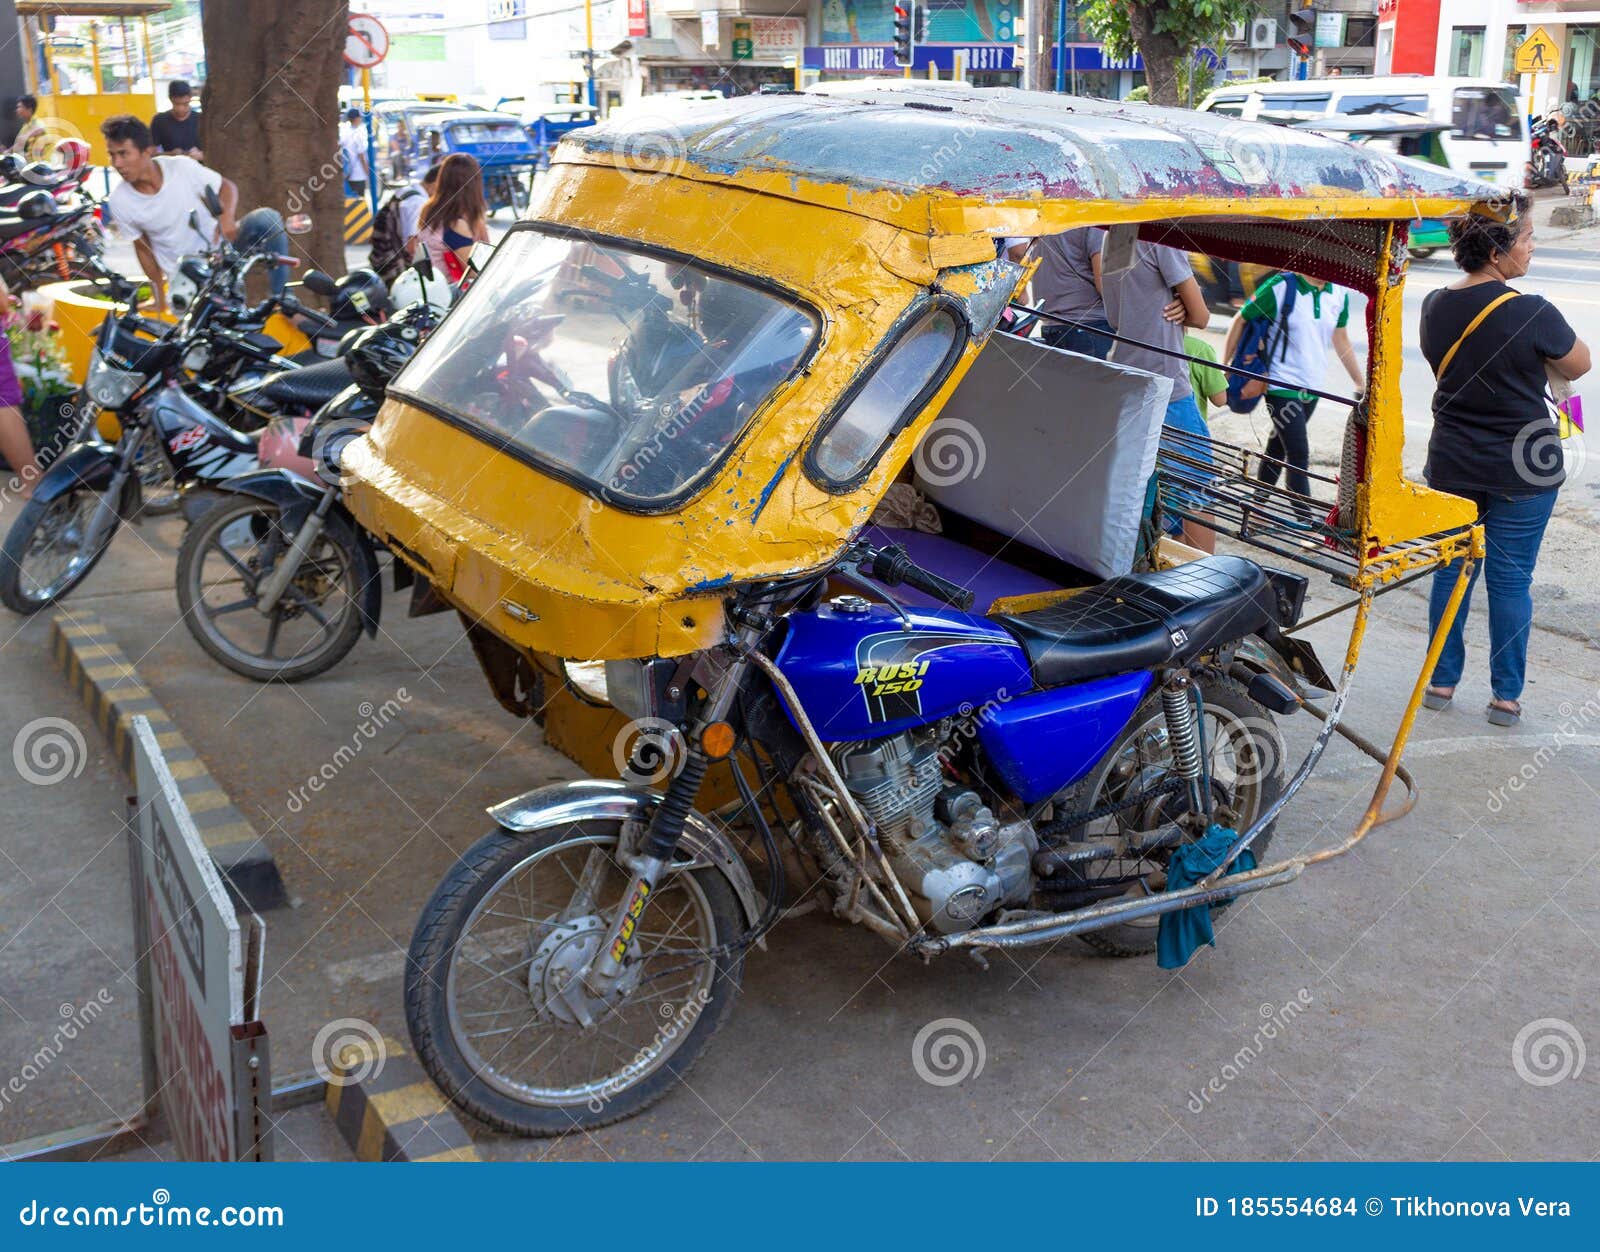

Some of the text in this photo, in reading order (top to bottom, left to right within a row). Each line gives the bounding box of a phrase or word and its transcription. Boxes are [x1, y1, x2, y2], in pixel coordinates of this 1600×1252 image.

[858, 48, 884, 69] LOPEZ
[853, 660, 931, 685] RUSI
[872, 679, 923, 696] 150
[610, 878, 651, 964] RUSI
